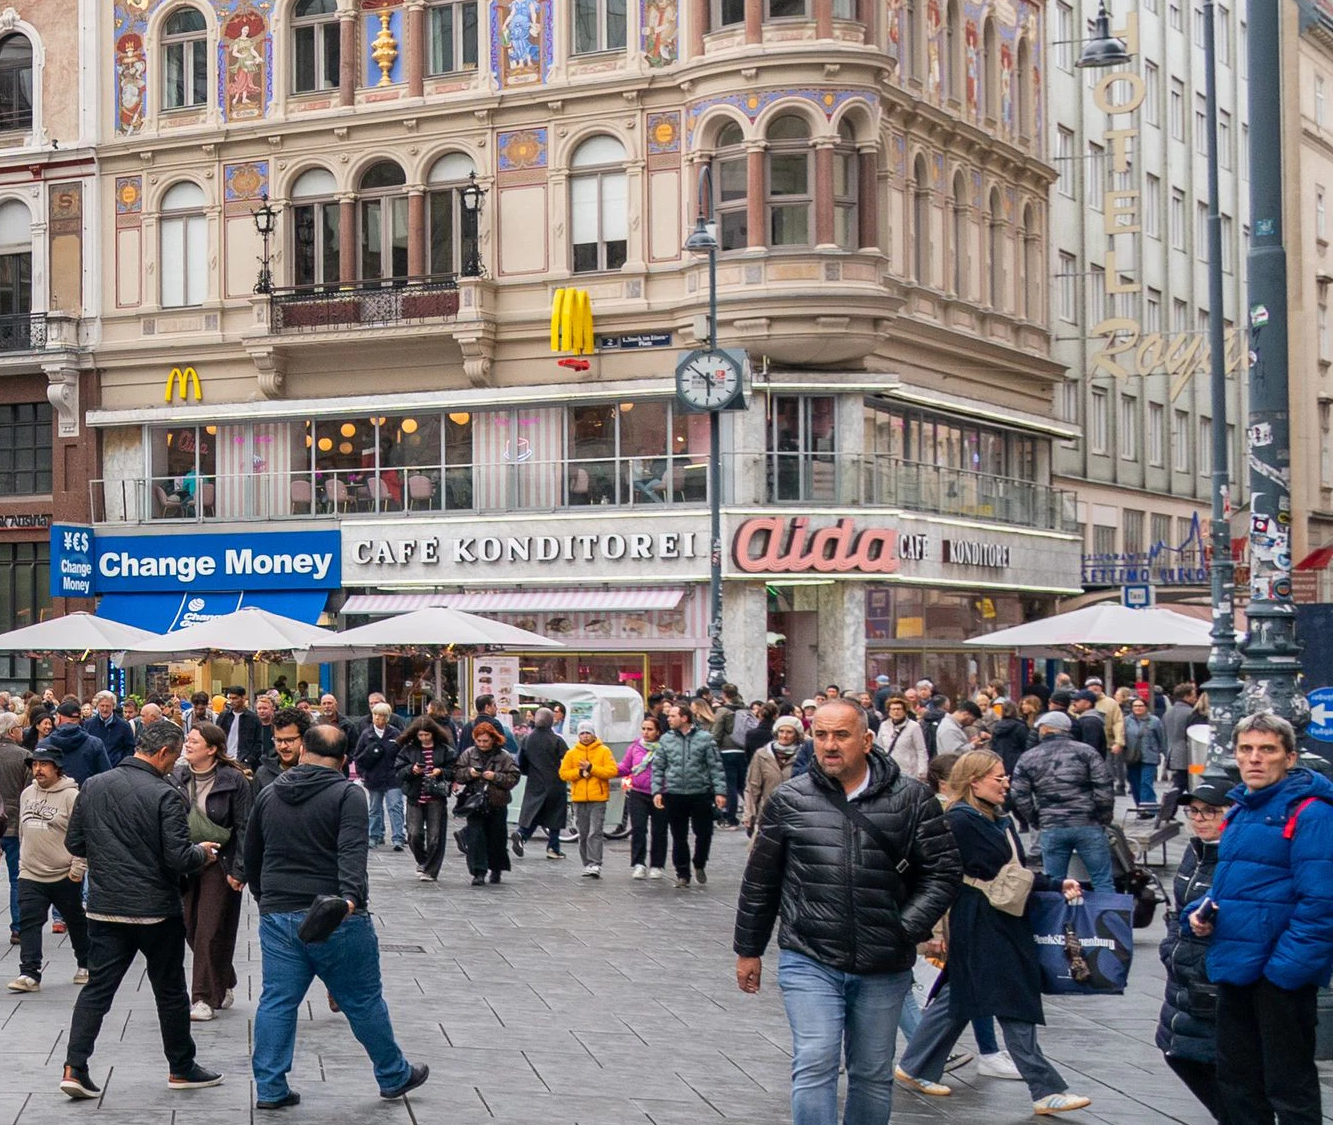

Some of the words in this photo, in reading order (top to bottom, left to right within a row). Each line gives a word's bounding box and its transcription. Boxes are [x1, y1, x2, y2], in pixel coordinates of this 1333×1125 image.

[9, 513, 47, 528] Austria
[351, 537, 439, 564] CAFÉ
[453, 532, 696, 564] KONDITOREI
[949, 539, 1013, 567] KONDITOREI
[61, 559, 92, 577] Change
[98, 551, 216, 582] Change
[225, 549, 333, 580] Money
[1081, 569, 1150, 583] SETTIMO
[62, 577, 90, 594] Money
[1129, 590, 1145, 600] Taxi
